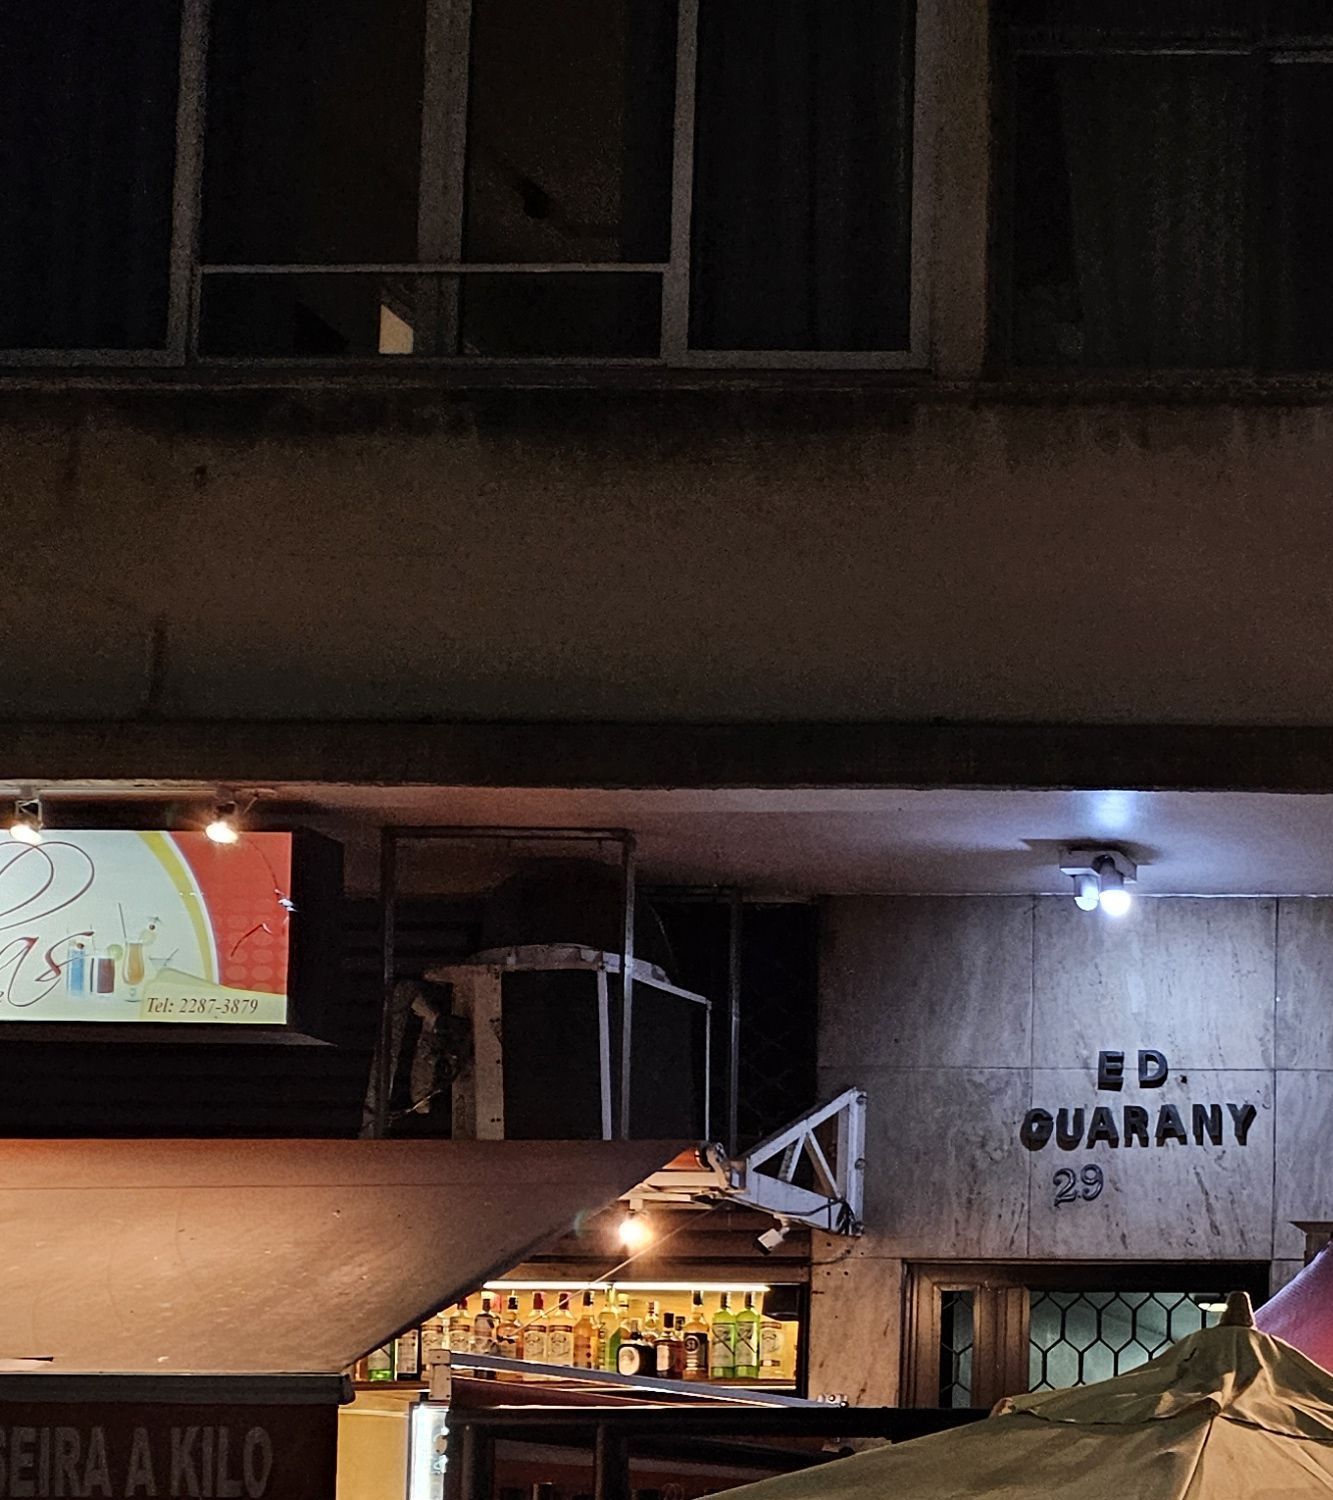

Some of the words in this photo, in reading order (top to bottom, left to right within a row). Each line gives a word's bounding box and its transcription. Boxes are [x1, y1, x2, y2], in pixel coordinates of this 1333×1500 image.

[147, 997, 174, 1014] Tel:
[179, 998, 258, 1014] 2287-3879
[1019, 1102, 1257, 1151] GUARANY
[1053, 1163, 1104, 1208] 29
[0, 1426, 113, 1498] EIRA
[124, 1426, 157, 1498] A
[169, 1426, 273, 1498] KILO
